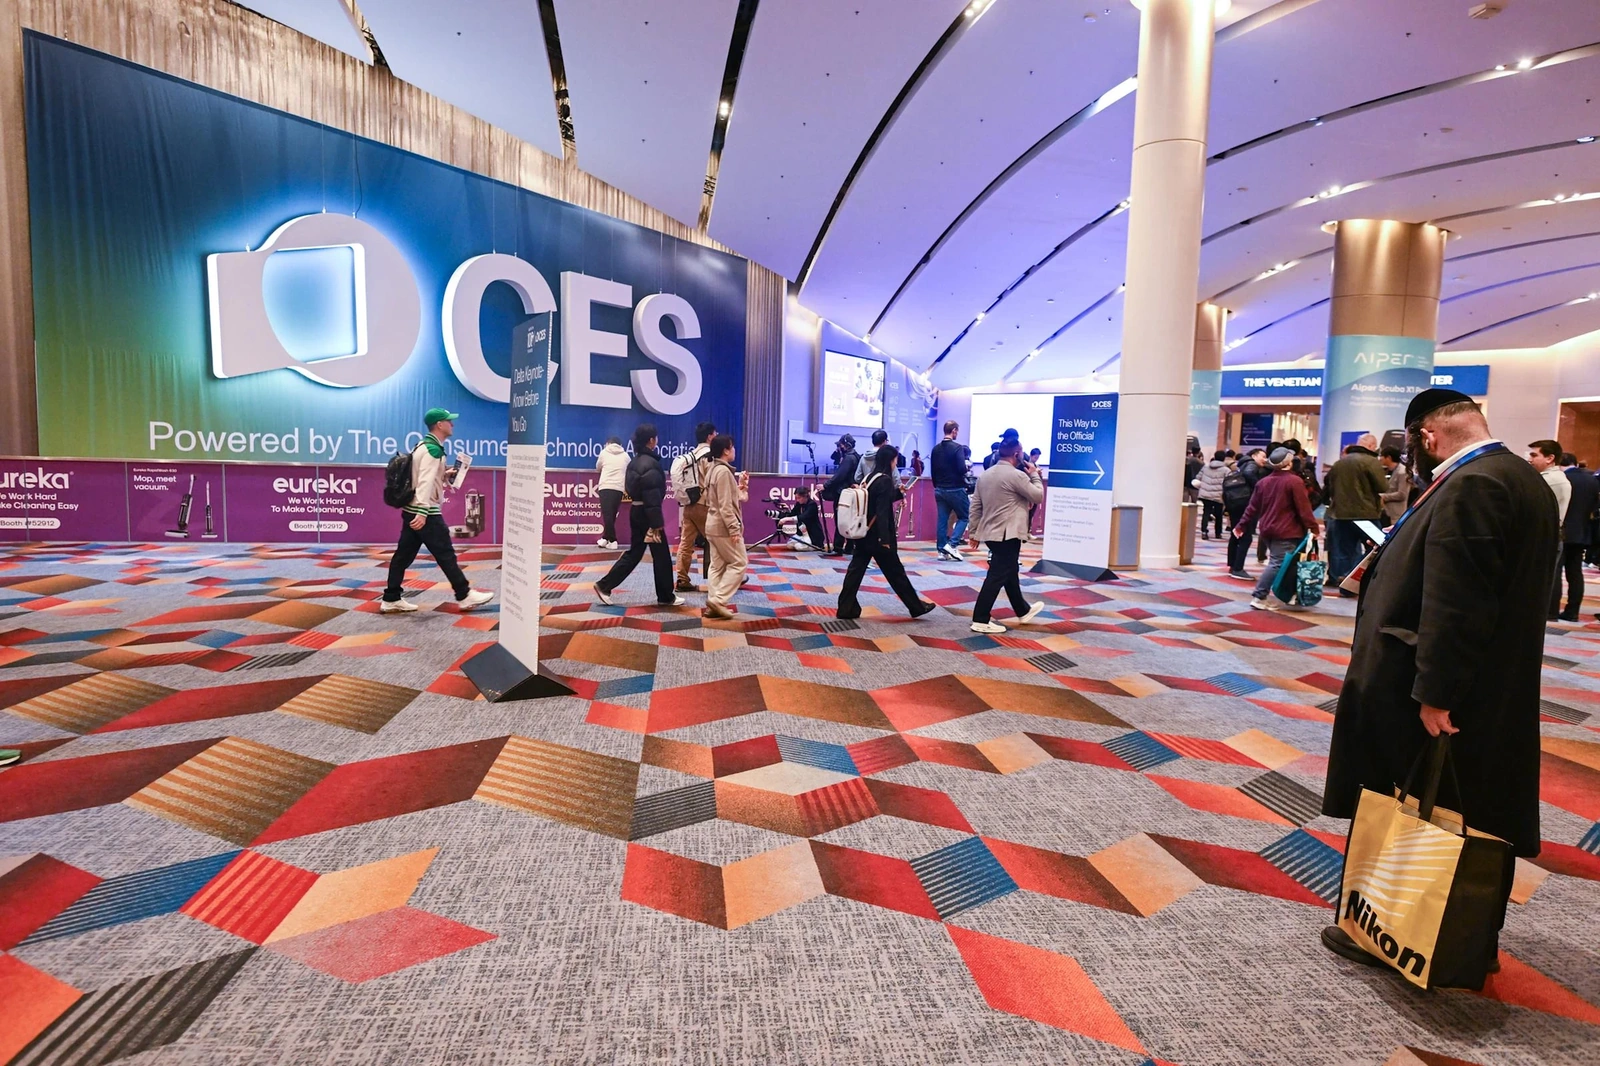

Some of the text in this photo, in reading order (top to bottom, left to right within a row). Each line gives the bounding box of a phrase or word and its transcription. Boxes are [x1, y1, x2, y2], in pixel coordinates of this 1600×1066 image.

[441, 253, 703, 415] CES
[1243, 377, 1265, 387] THE
[1265, 377, 1321, 387] VENETIAN
[1378, 384, 1405, 393] Scuba
[525, 389, 539, 406] Before
[512, 416, 527, 432] You Go
[1058, 419, 1099, 430] This Way to
[1057, 431, 1095, 440] the Official
[149, 421, 299, 454] Powered
[309, 428, 343, 461] by
[347, 429, 398, 454] The
[405, 432, 508, 457] Cnsume
[1056, 443, 1093, 453] CES Store
[0, 467, 69, 489] ureka
[133, 475, 177, 484] Mop, meet
[273, 473, 357, 494] eureka
[544, 479, 600, 498] eurek
[8, 492, 33, 500] Work
[326, 497, 346, 505] Hard
[13, 501, 56, 511] Cleaning
[57, 502, 79, 511] Easy
[271, 505, 364, 515] To Make Cleaning Easy
[551, 501, 563, 509] We
[564, 501, 584, 509] Work
[568, 510, 601, 518] Cleaning
[1344, 890, 1427, 978] Nikon
